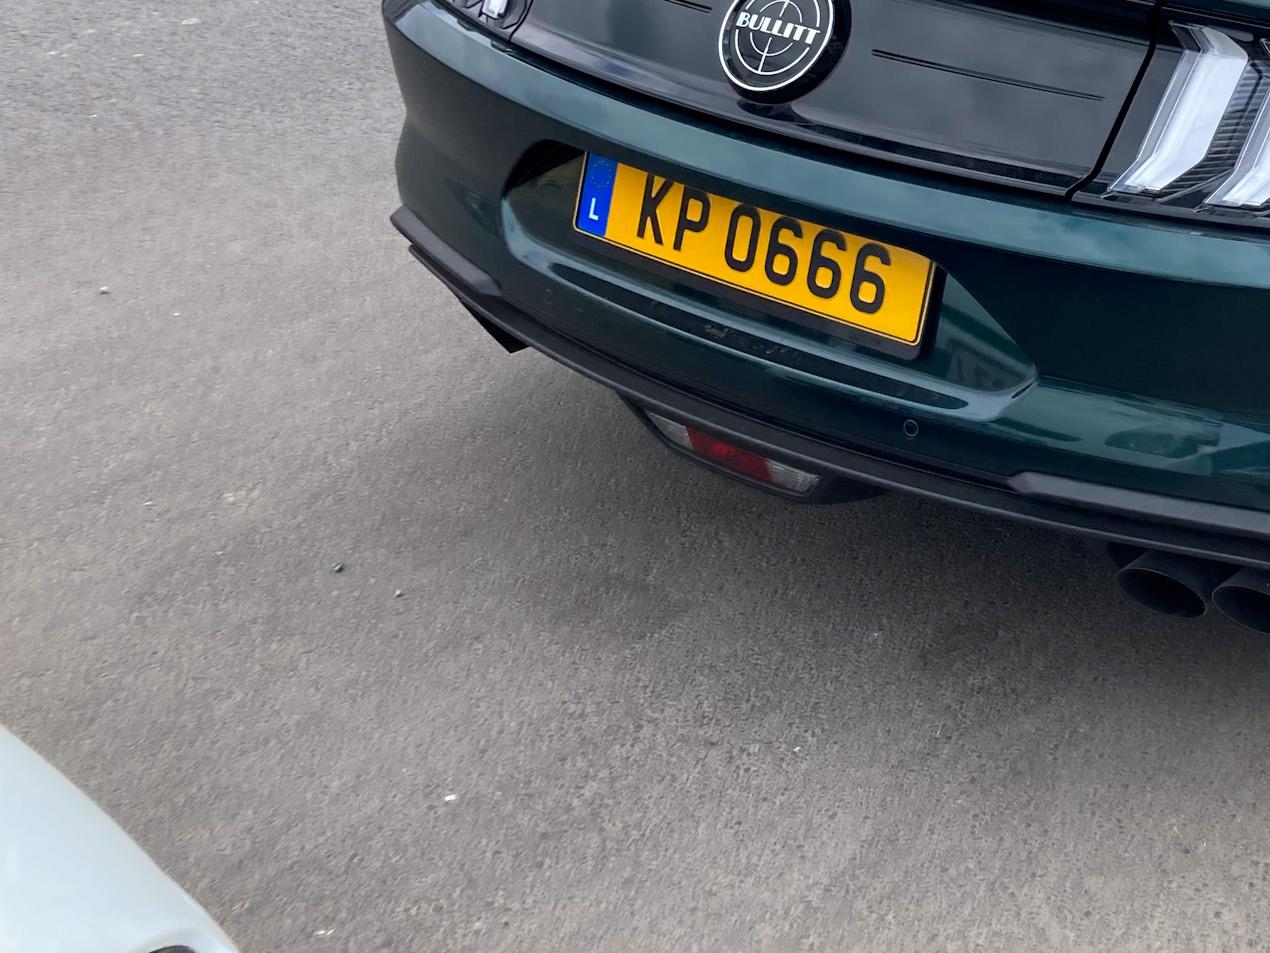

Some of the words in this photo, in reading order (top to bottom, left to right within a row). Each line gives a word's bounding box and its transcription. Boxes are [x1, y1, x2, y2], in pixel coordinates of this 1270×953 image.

[735, 11, 821, 45] BULLITT
[588, 197, 599, 221] L
[637, 170, 712, 252] KP
[724, 203, 892, 315] 0666
